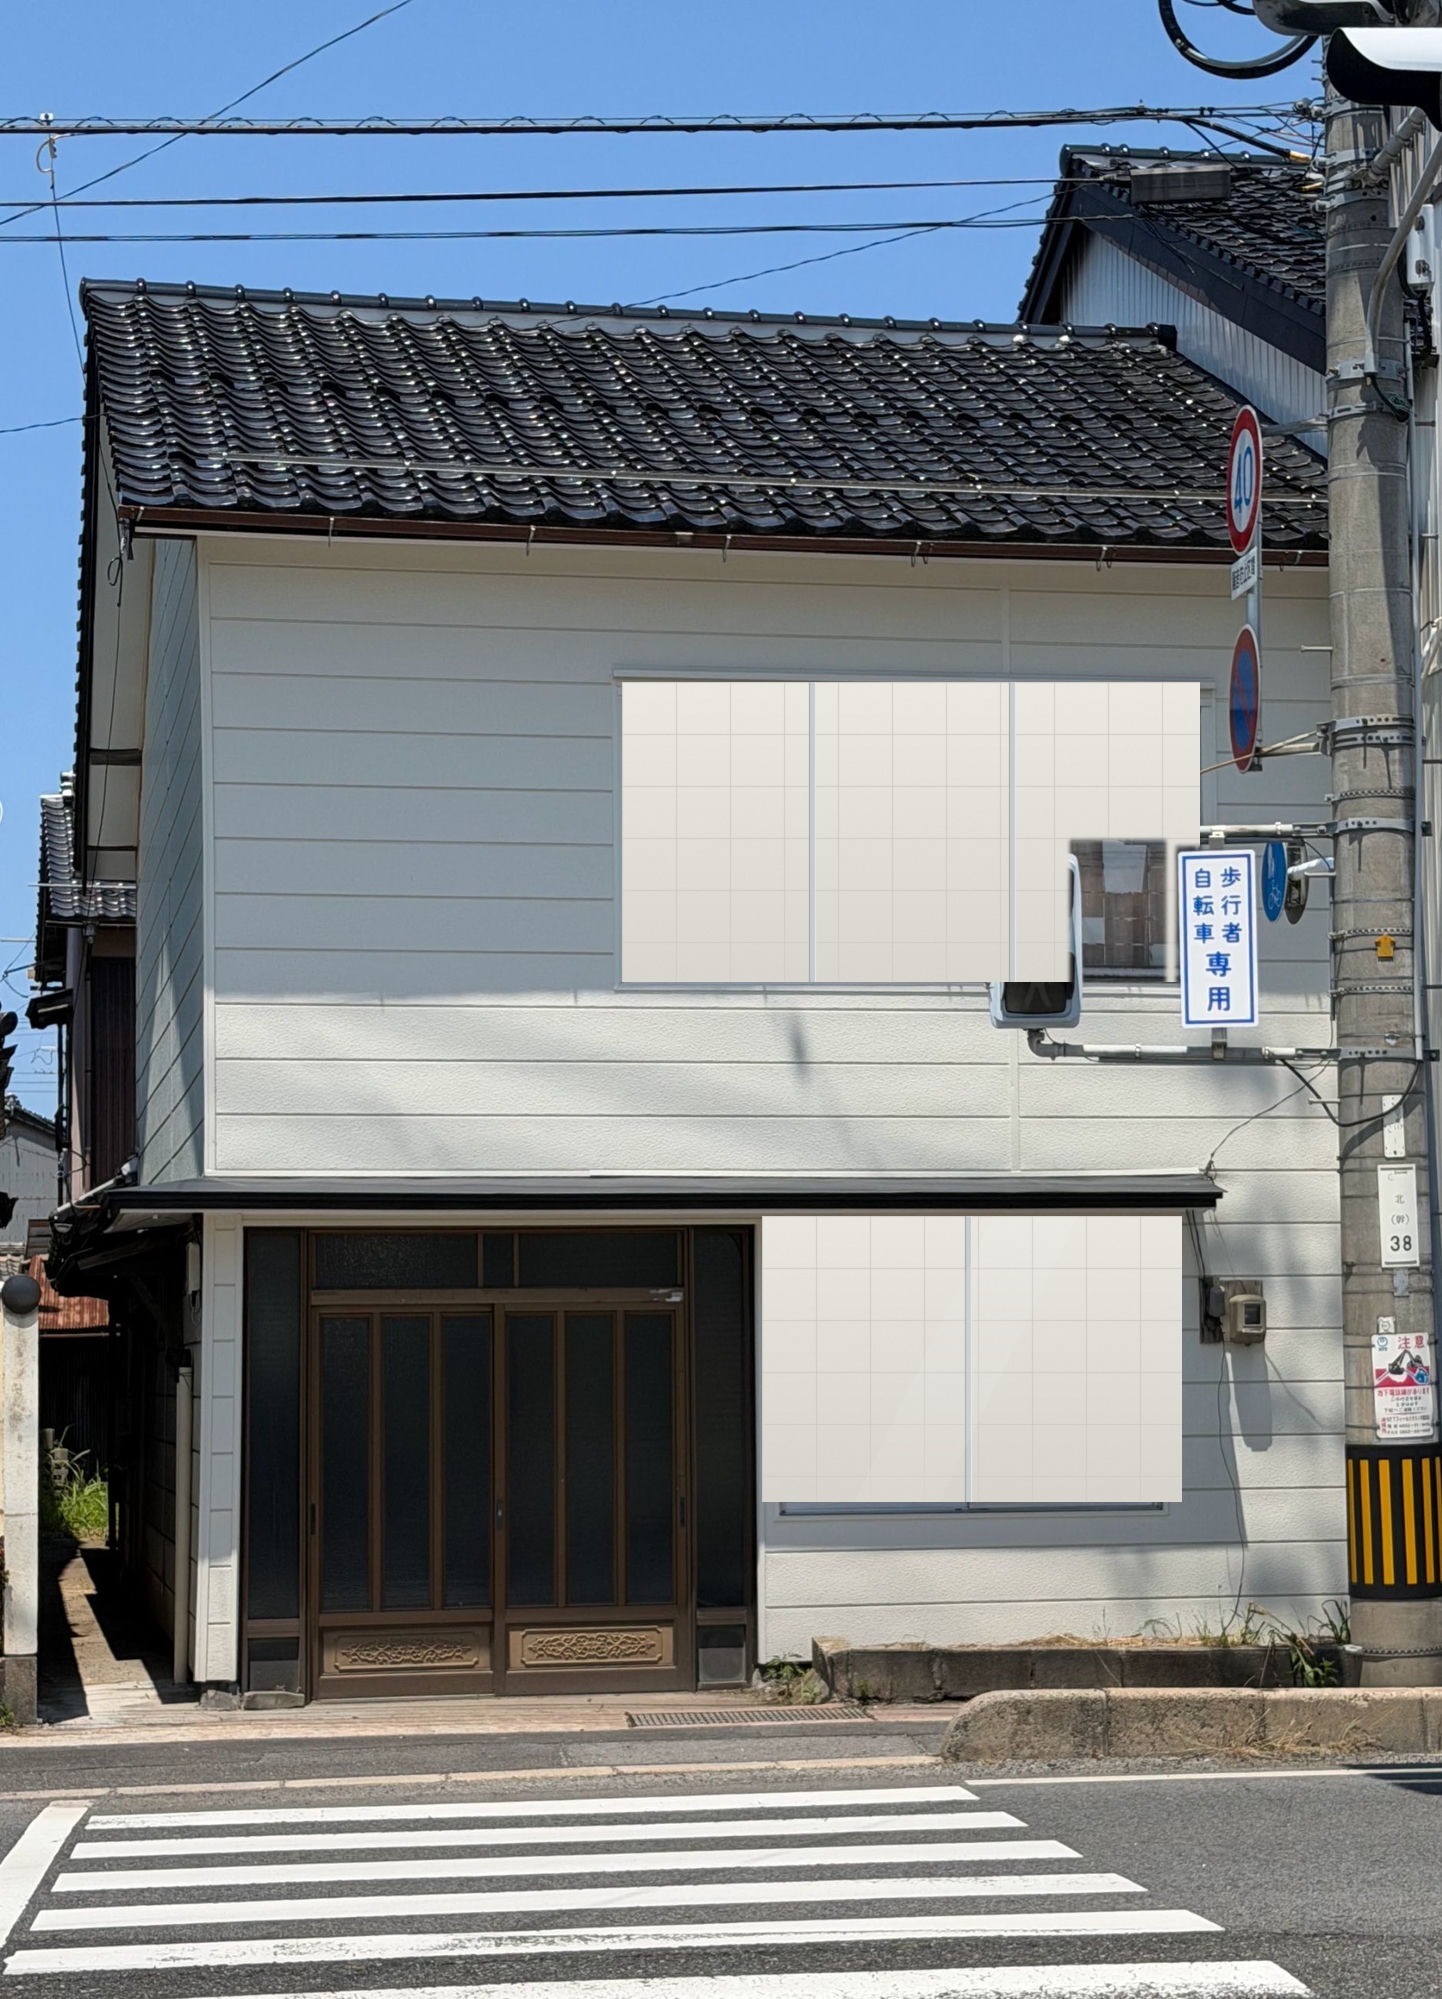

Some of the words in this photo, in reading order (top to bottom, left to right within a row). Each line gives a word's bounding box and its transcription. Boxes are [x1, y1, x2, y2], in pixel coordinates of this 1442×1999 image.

[1234, 446, 1253, 513] 40
[1193, 868, 1215, 944] 自転車
[1220, 866, 1242, 944] 歩行者
[1205, 951, 1232, 1012] 専用
[1390, 1235, 1412, 1251] 38
[1397, 1335, 1425, 1350] 注意
